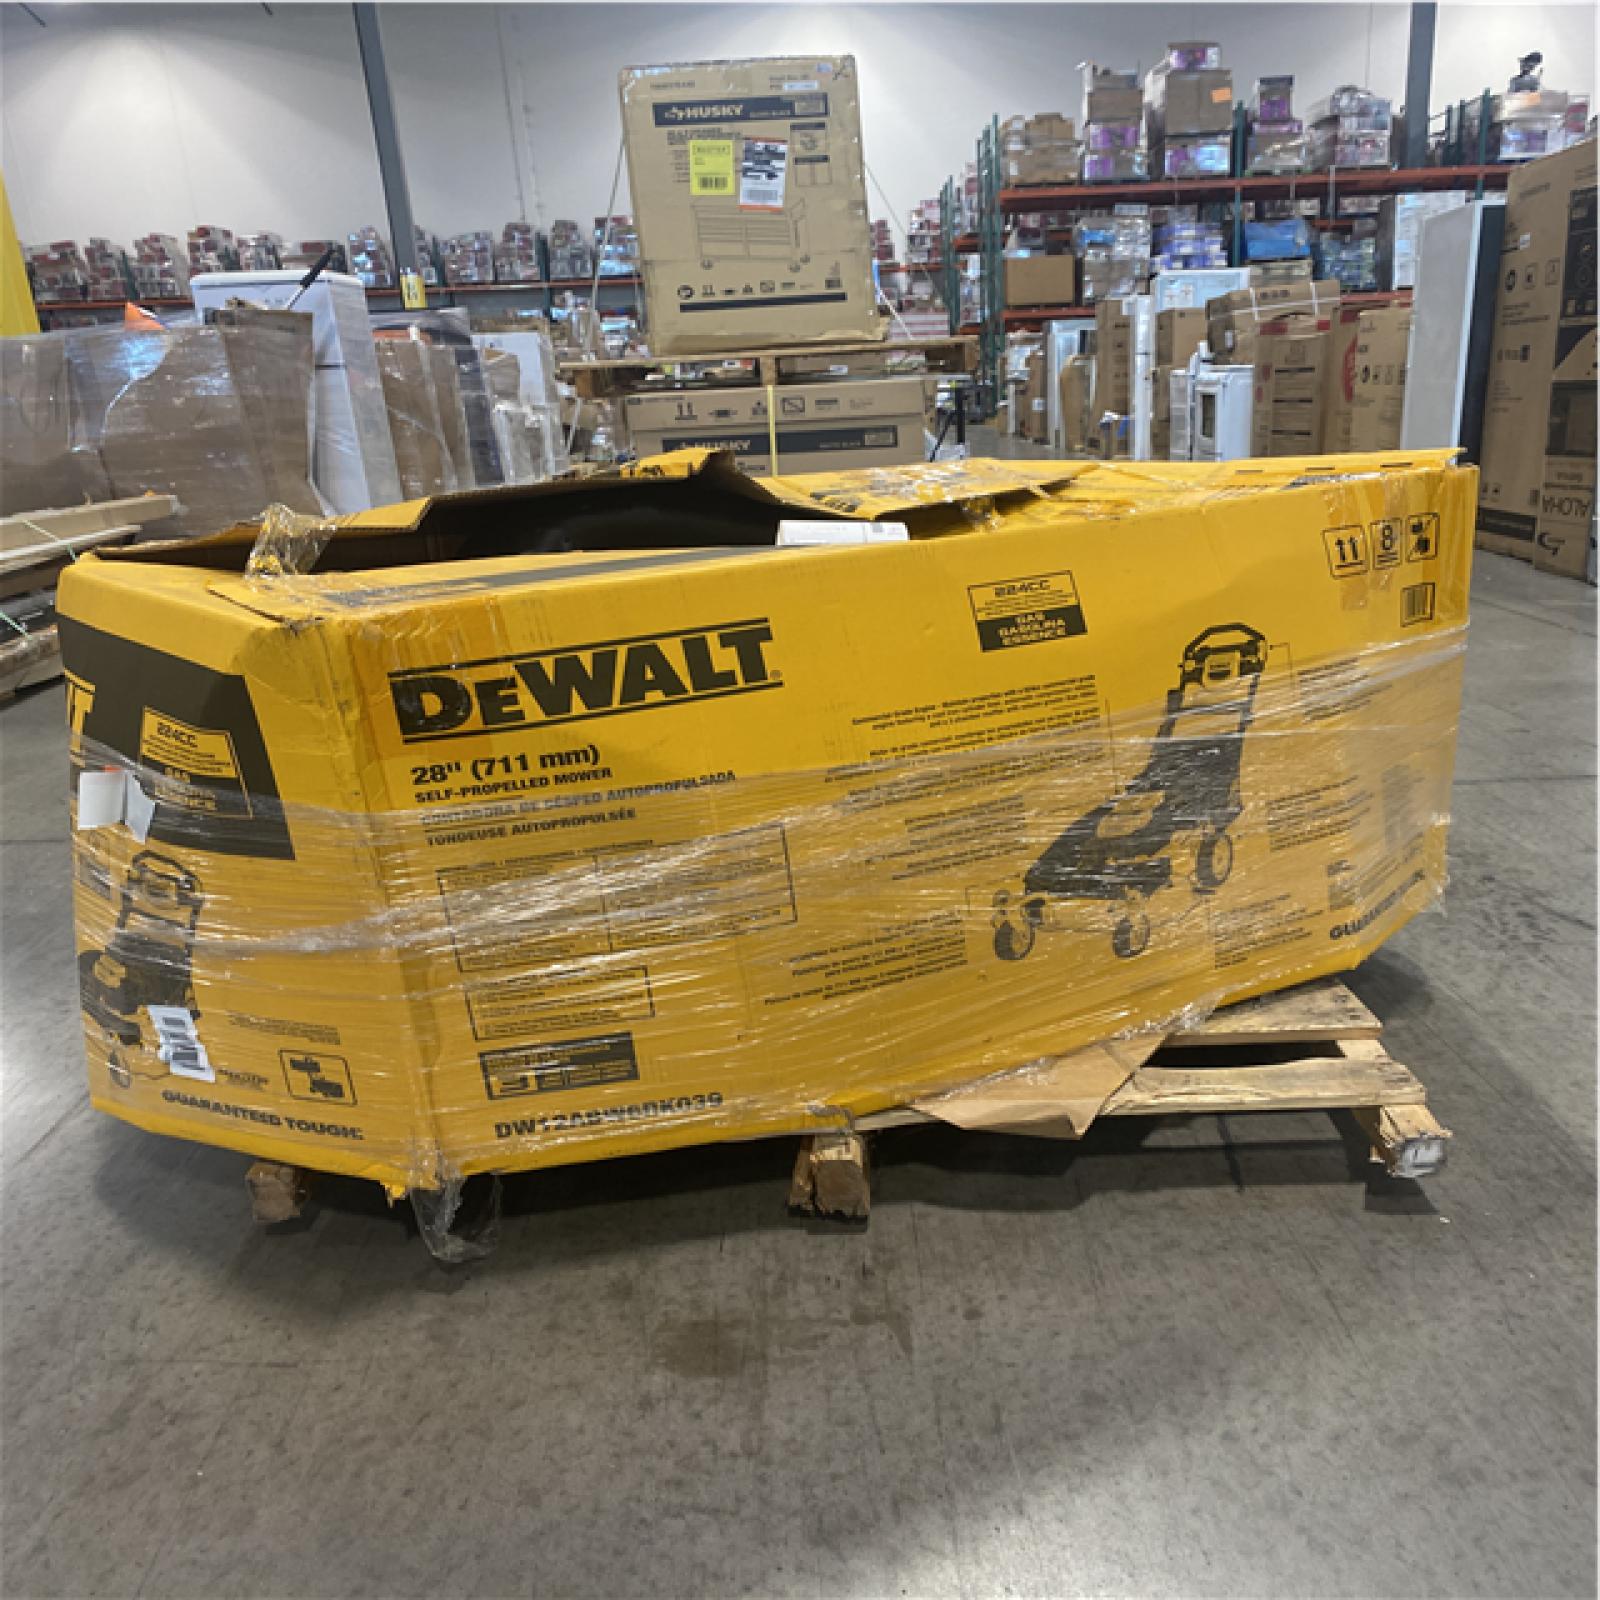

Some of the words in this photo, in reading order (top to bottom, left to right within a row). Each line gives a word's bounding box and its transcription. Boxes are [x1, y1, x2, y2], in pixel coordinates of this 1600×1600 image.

[687, 104, 743, 120] HUSKY
[471, 752, 529, 781] (711
[538, 744, 600, 769] mm)
[414, 776, 550, 803] SELF-PROPELLED
[553, 767, 613, 786] MOWER
